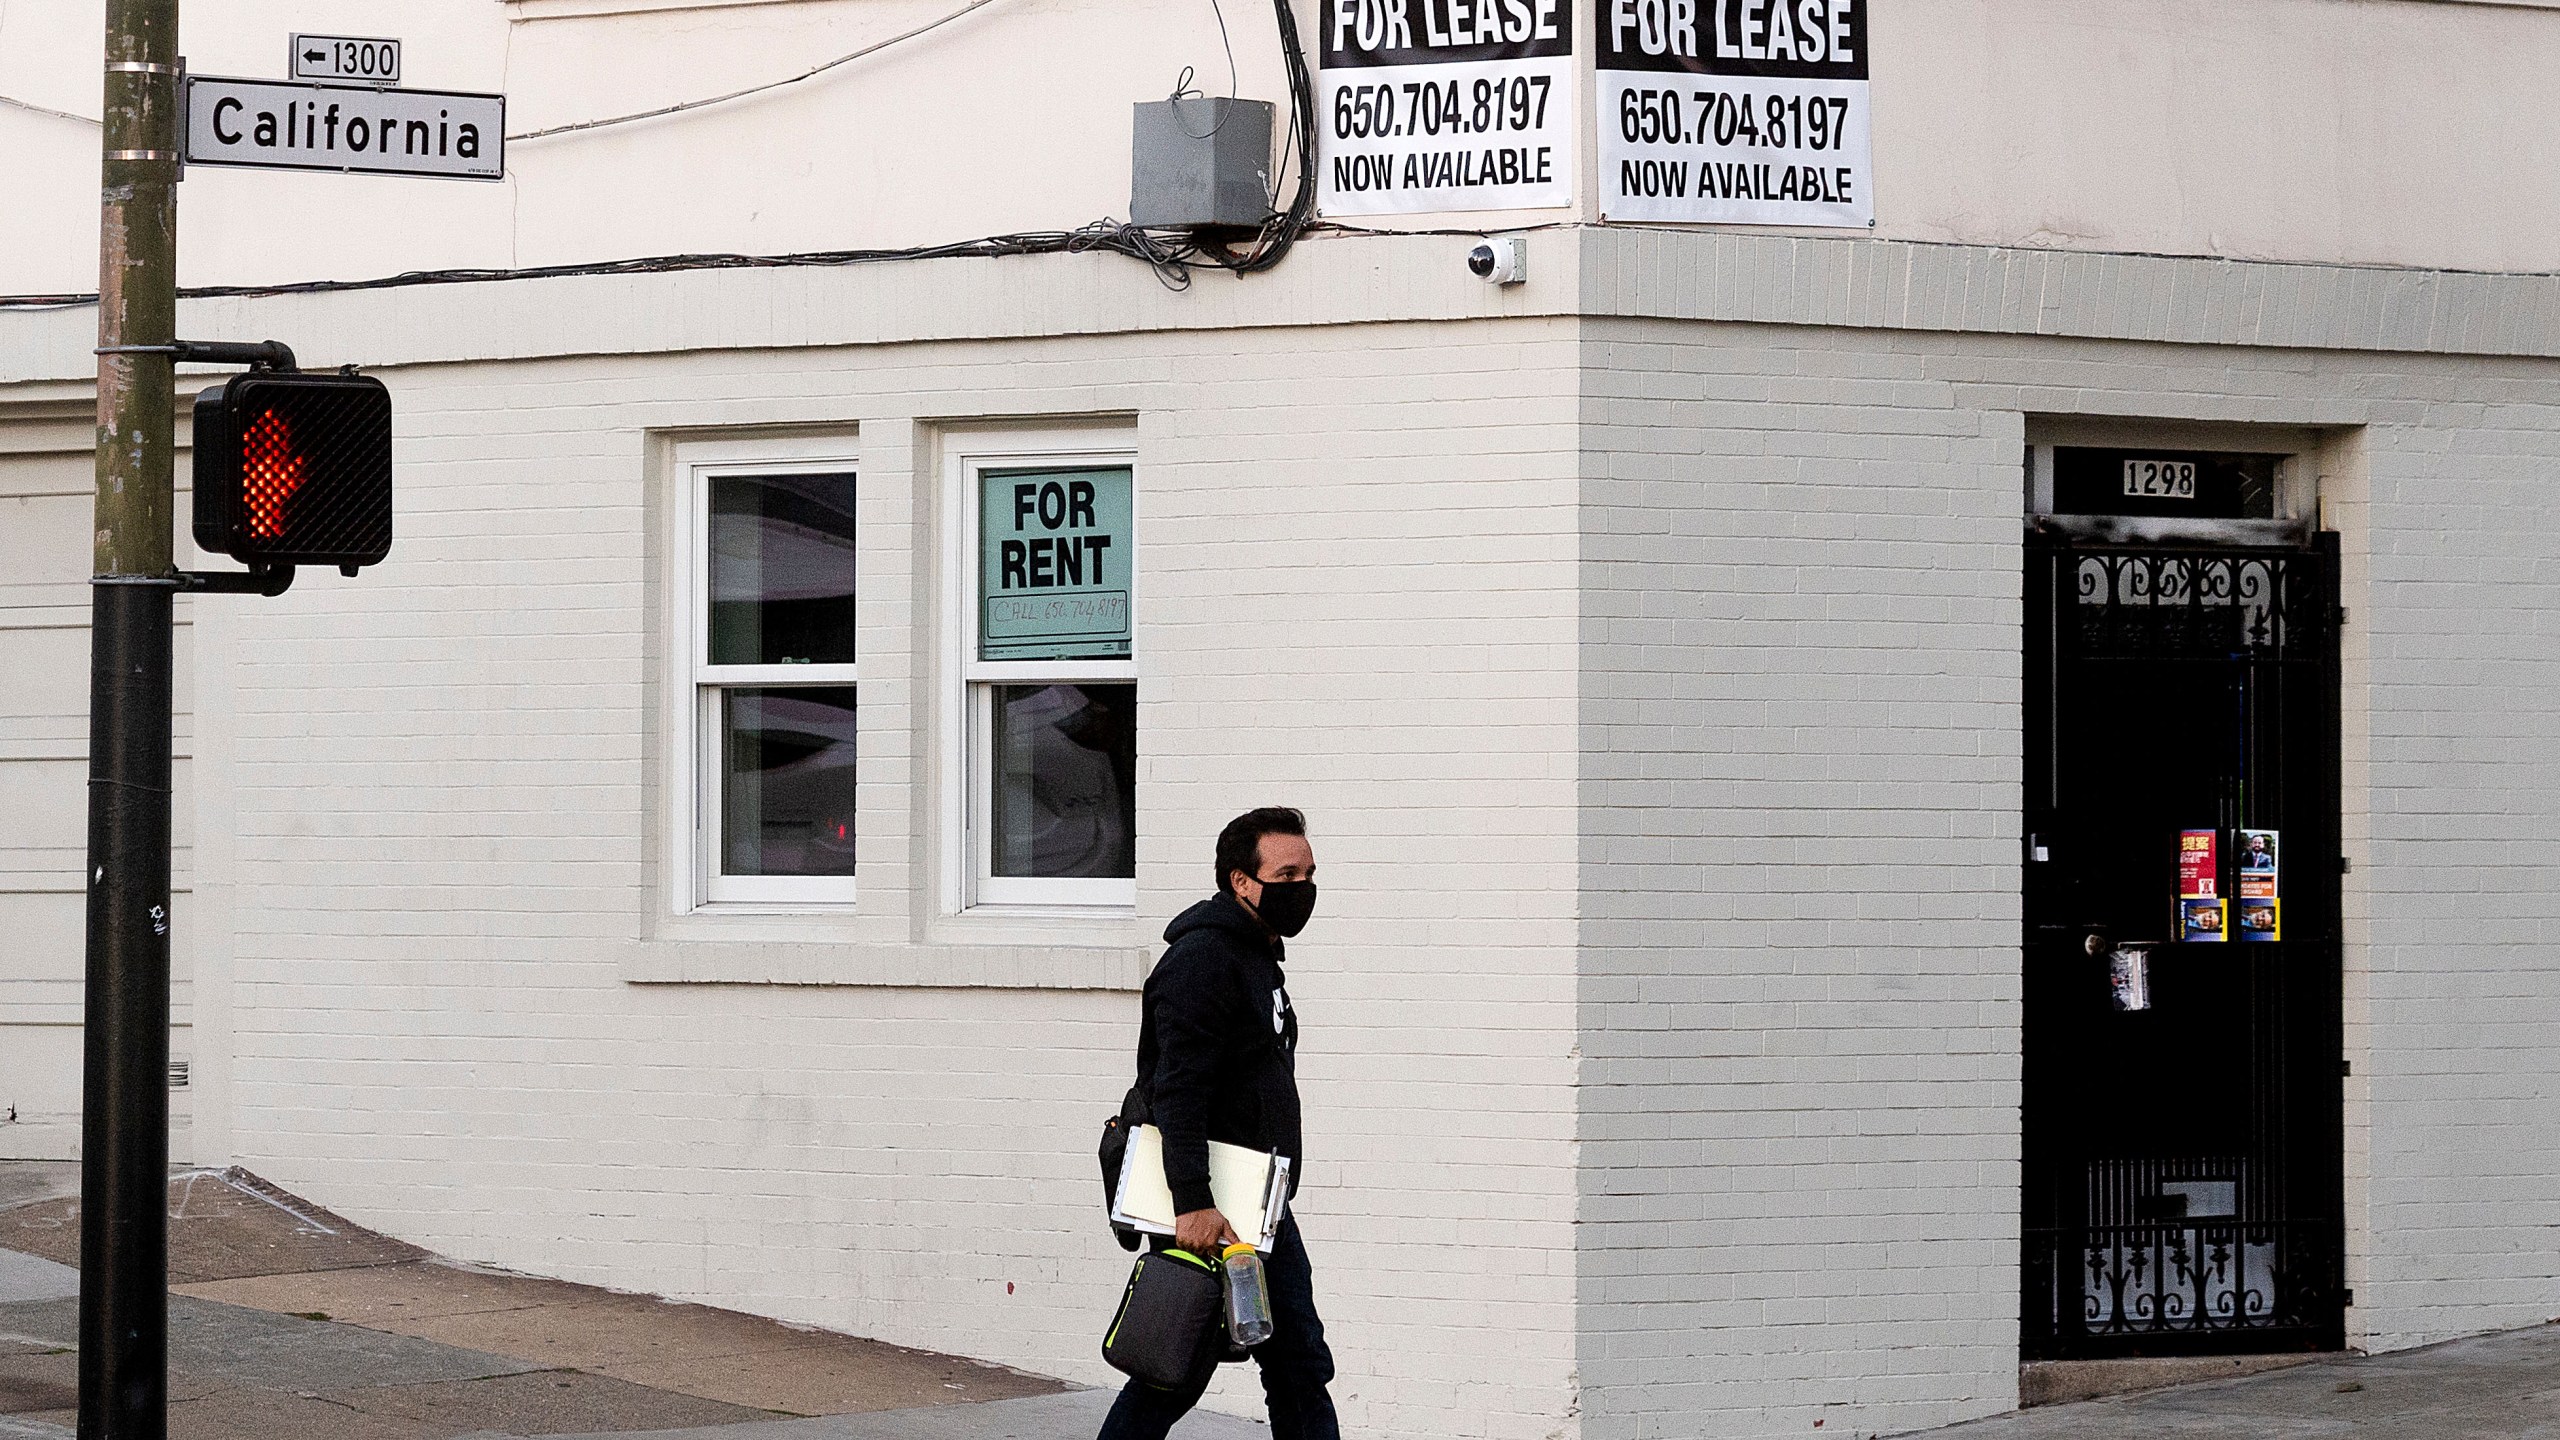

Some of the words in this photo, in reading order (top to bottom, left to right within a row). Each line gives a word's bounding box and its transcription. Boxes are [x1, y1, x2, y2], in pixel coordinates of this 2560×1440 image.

[1332, 0, 1412, 52] FOR
[1423, 0, 1558, 48] LEASE
[1610, 0, 1698, 57] FOR
[1715, 0, 1854, 63] LEASE
[333, 41, 395, 76] 1300
[211, 96, 480, 159] California
[1334, 75, 1551, 139] 650.704.8197
[1620, 88, 1849, 151] 650.704.8197
[1334, 154, 1394, 192] NOW
[1403, 147, 1552, 189] AVAILABLE
[1621, 160, 1688, 198] NOW
[1697, 162, 1853, 203] AVAILABLE
[2128, 462, 2193, 495] 1298
[1014, 481, 1096, 531] FOR
[1001, 535, 1111, 589] RENT
[994, 601, 1038, 622] CALL
